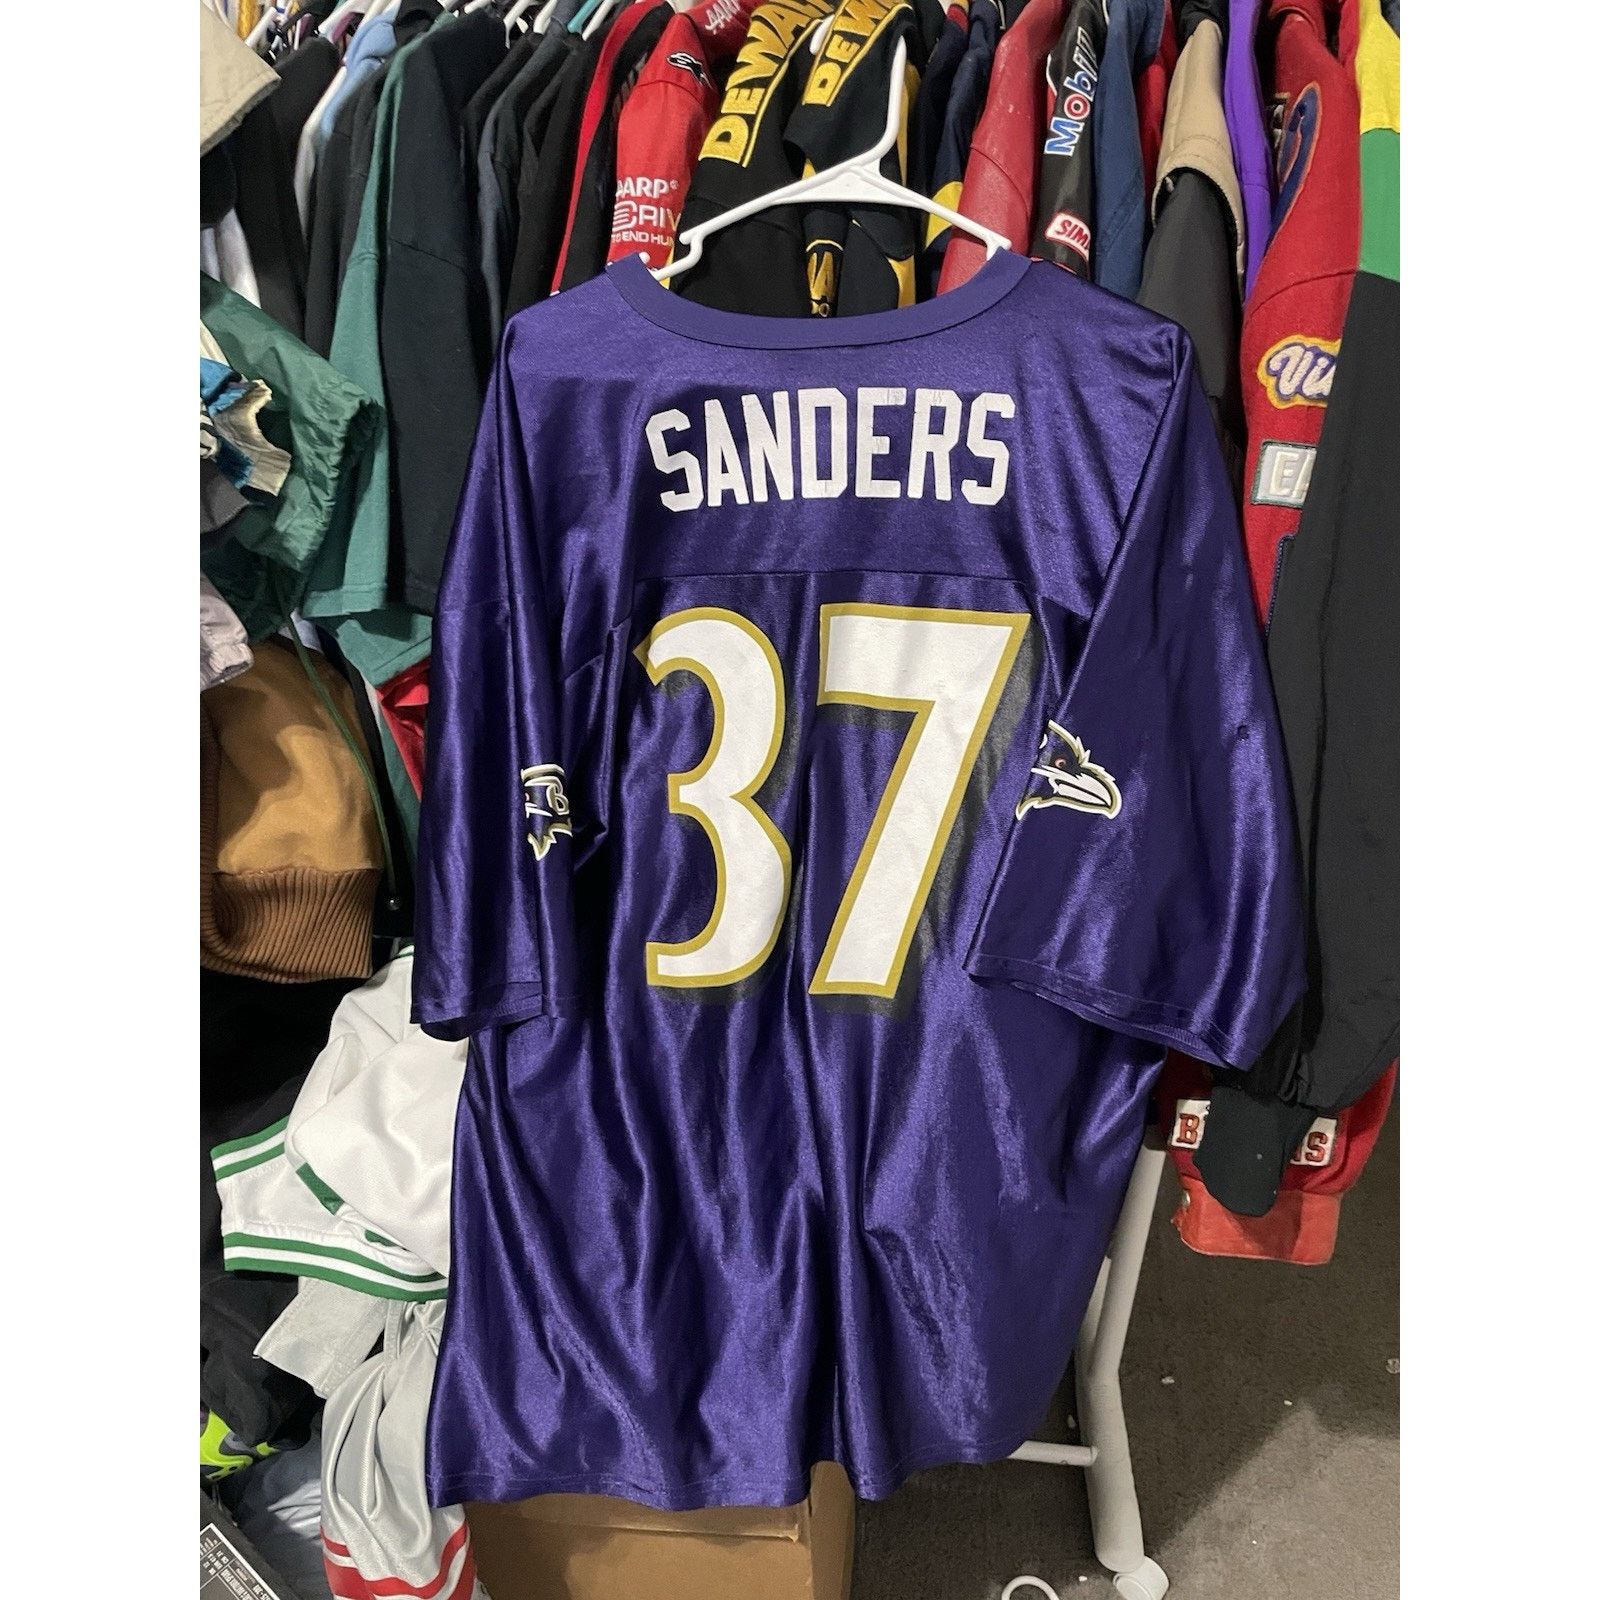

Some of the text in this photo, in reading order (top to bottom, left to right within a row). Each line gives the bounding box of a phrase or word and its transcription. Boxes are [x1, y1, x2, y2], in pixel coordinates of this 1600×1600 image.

[622, 230, 649, 243] END
[645, 387, 1016, 513] SANDERS
[633, 602, 1031, 1000] 37
